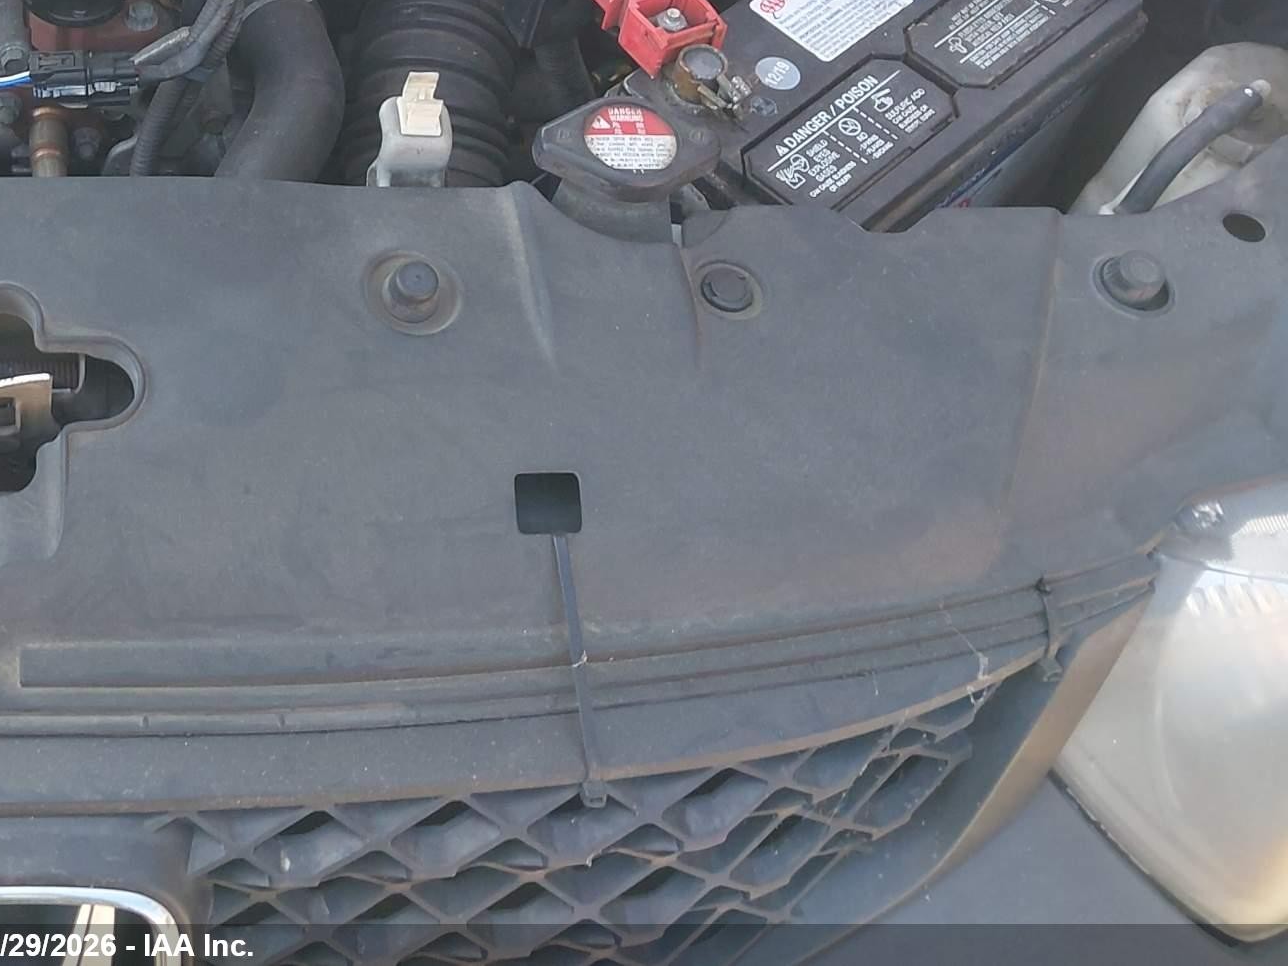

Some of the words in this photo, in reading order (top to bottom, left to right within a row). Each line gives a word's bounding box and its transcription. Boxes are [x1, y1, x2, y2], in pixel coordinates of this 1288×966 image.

[765, 61, 791, 86] 12/19
[783, 110, 832, 148] DANGER
[829, 104, 837, 117] /
[834, 75, 879, 110] POISON
[806, 139, 829, 157] SHIELD
[813, 149, 832, 163] EYES
[807, 152, 841, 177] EXPLOSIVE
[815, 165, 838, 182] GASES
